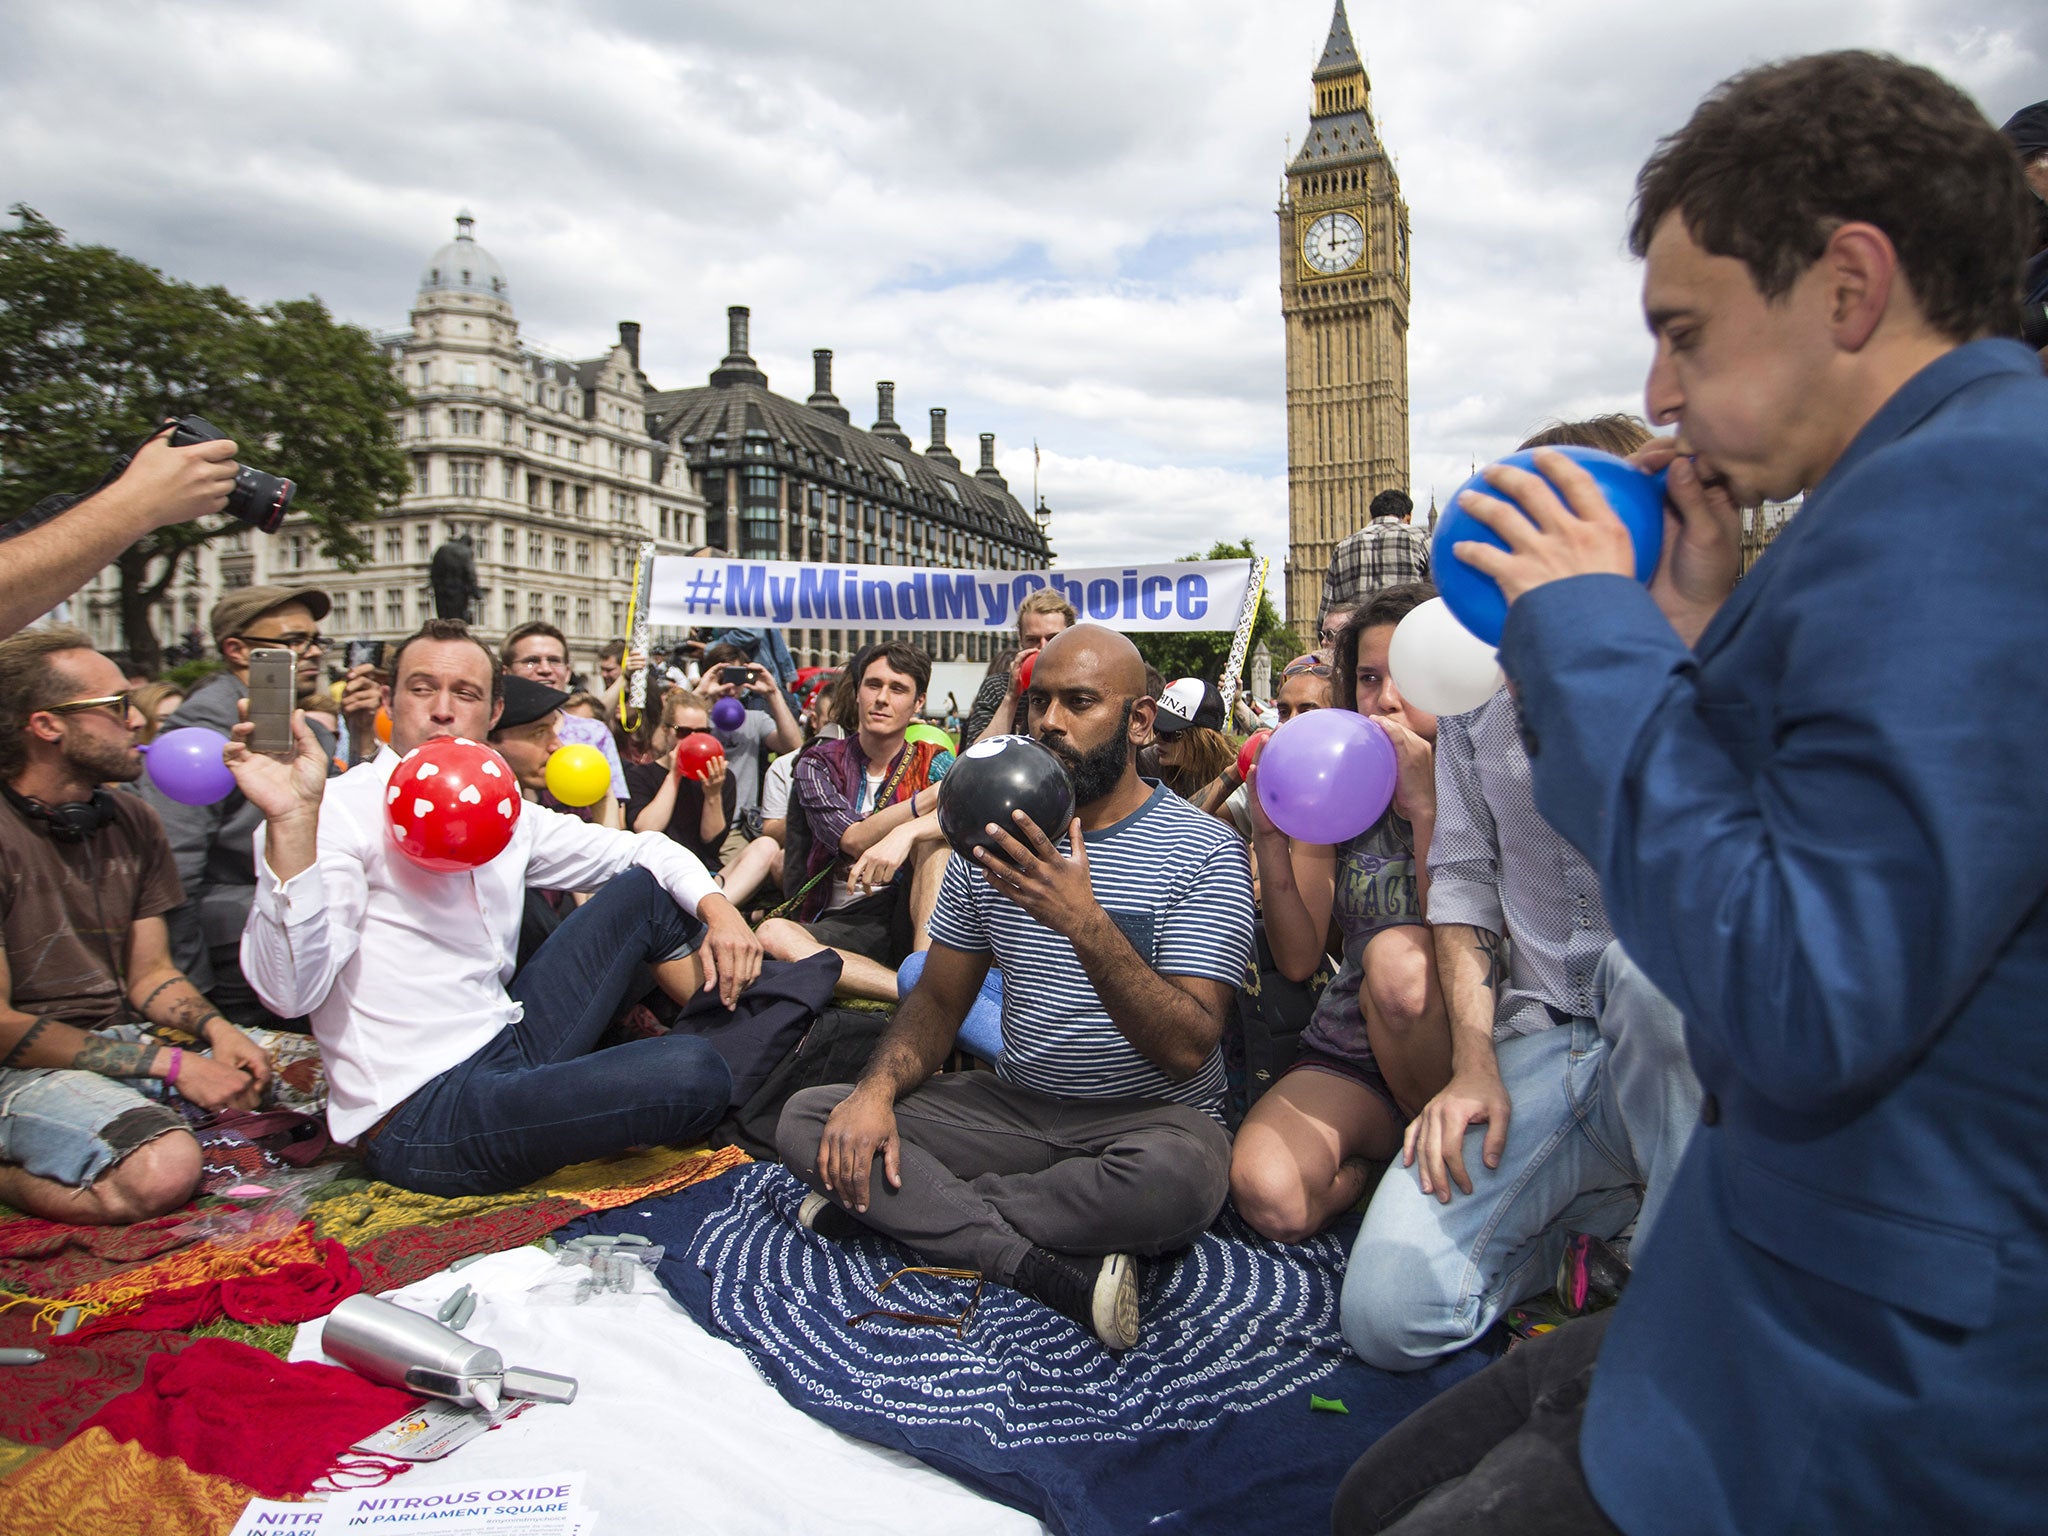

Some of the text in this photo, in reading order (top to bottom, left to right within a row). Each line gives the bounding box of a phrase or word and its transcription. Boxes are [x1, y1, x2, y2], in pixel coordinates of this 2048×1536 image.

[684, 565, 1208, 625] #MyMindMyChoice
[357, 1484, 572, 1512] NITROUS OXIDE
[349, 1502, 568, 1526] IN PARLIAMENT SQUARE
